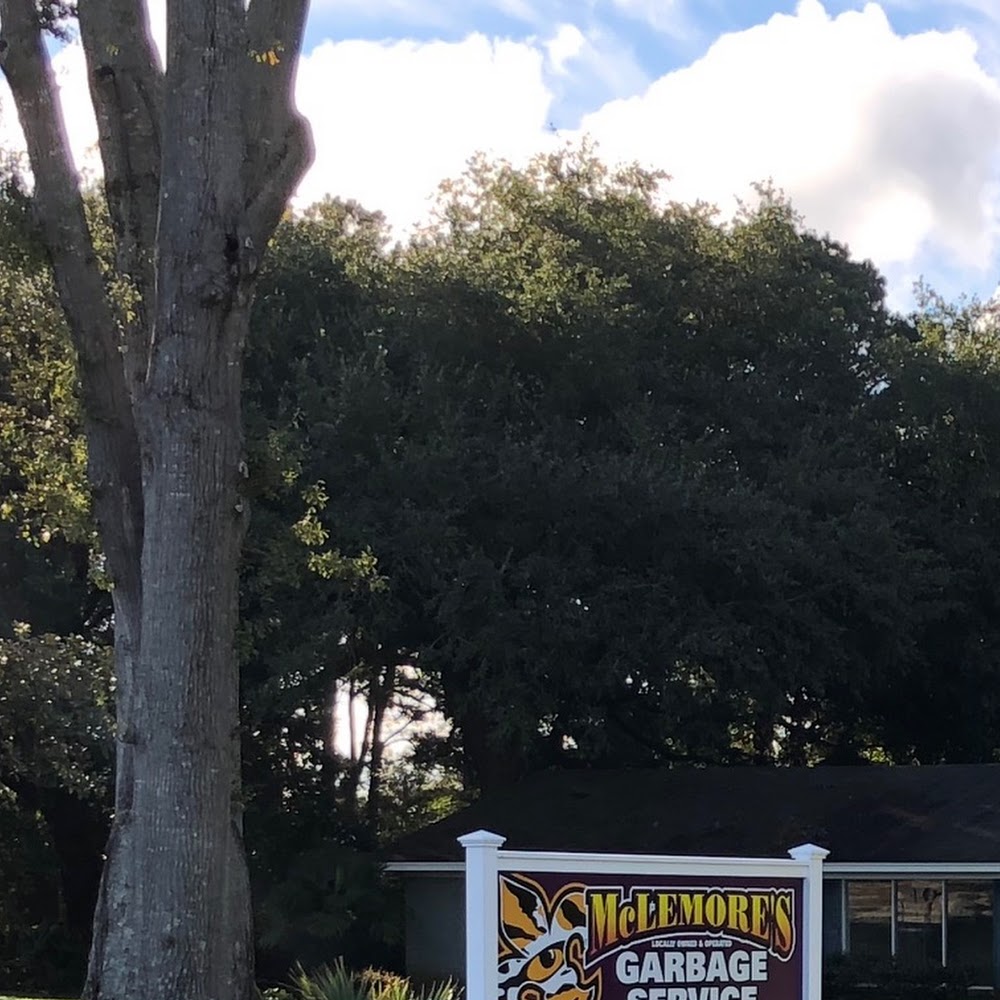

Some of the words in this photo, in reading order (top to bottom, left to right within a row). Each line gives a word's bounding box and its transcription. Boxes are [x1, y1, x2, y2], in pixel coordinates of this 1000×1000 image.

[589, 892, 793, 955] McLEMORE'S
[651, 939, 676, 948] LOCALLY
[616, 950, 768, 985] GARBAGE
